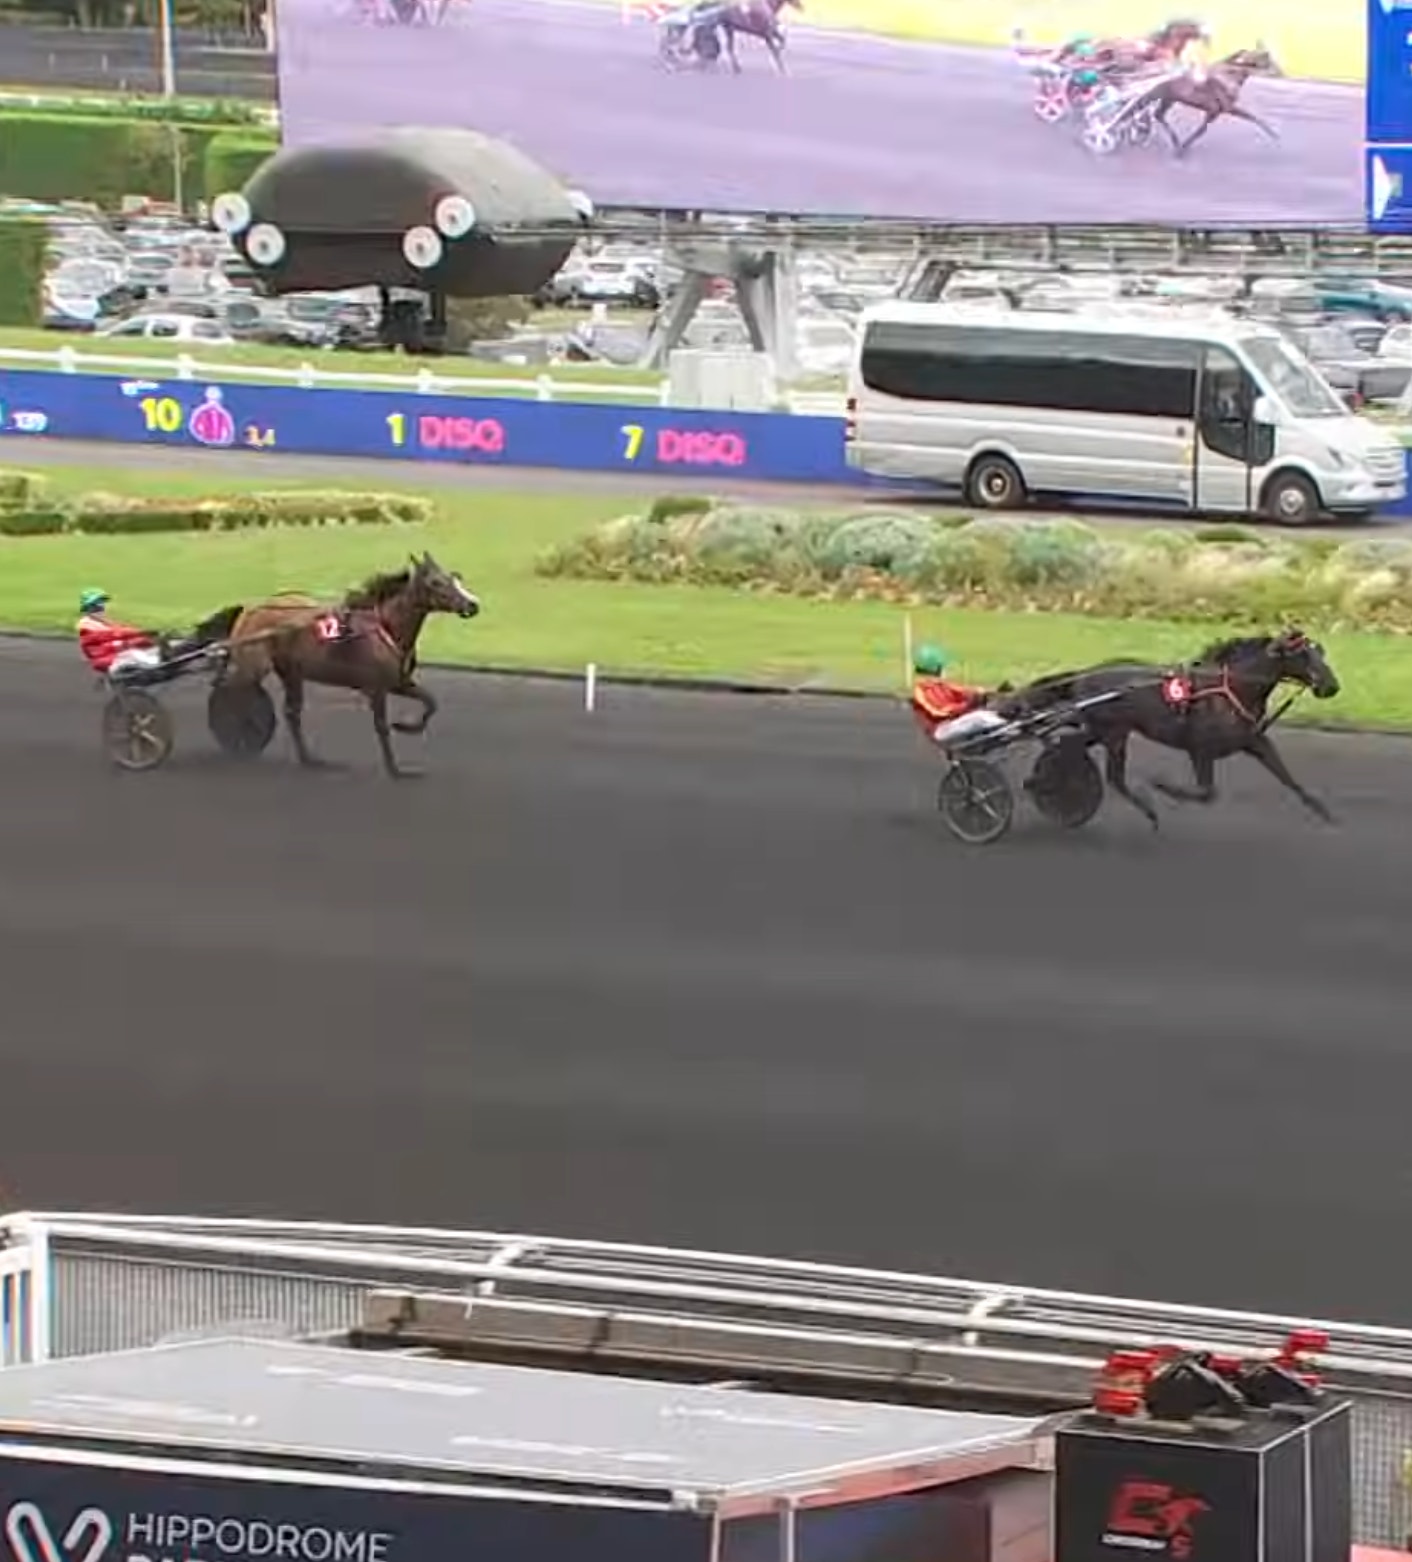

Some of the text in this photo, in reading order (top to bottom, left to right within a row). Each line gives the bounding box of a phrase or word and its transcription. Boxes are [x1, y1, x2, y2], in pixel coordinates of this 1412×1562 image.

[139, 398, 183, 431] 10
[386, 413, 504, 451] 1 DISQ
[621, 424, 745, 466] 7 DISQ
[317, 617, 340, 638] 12
[1169, 677, 1184, 699] 6
[126, 1511, 396, 1561] HIPPODROME
